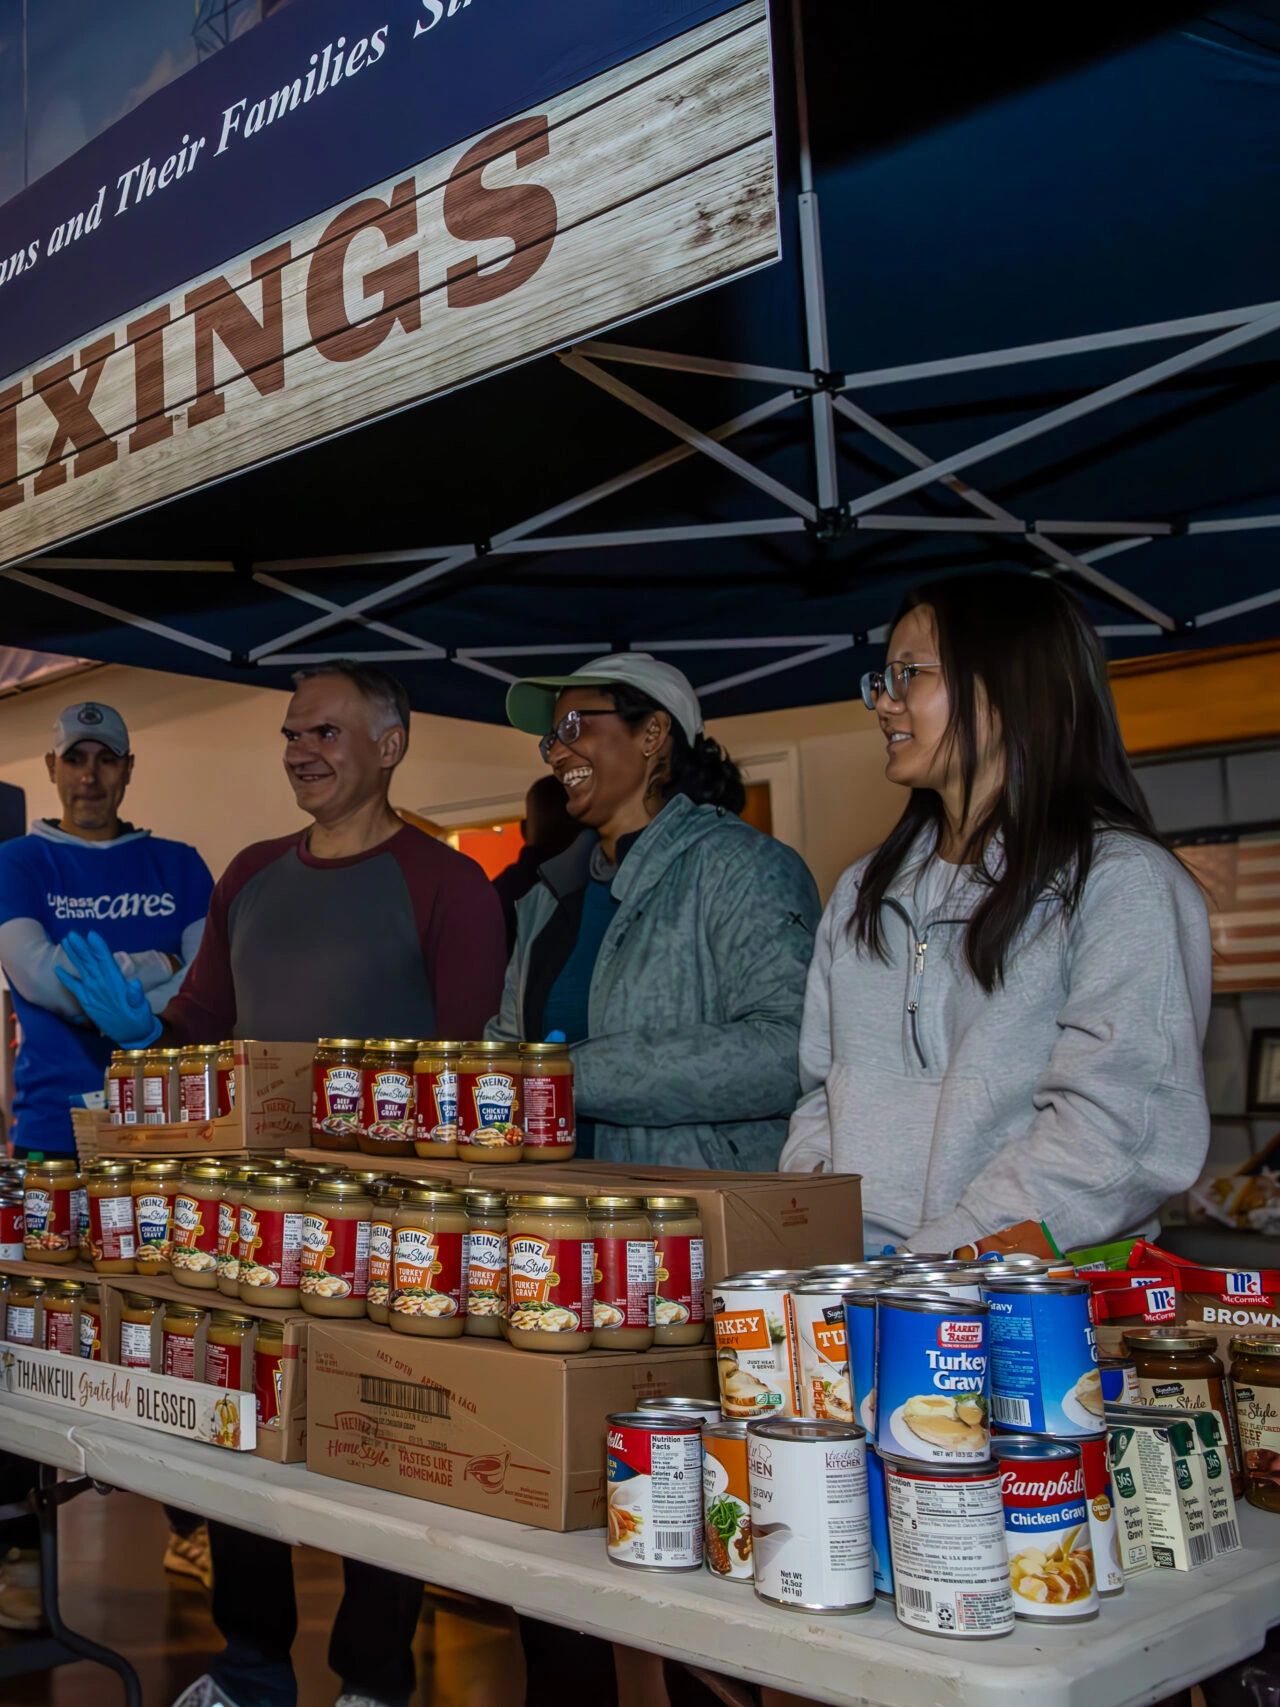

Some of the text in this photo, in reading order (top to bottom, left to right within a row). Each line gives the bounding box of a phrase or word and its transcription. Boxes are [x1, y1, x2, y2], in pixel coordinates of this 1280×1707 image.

[47, 185, 107, 256] and
[114, 134, 206, 217] Their
[213, 24, 388, 158] Families
[47, 892, 95, 907] UMass
[55, 906, 96, 919] Chan
[93, 893, 176, 920] cares
[331, 1070, 357, 1079] HEINZ
[381, 1075, 406, 1086] HEINZ
[481, 1077, 509, 1088] HEINZ
[475, 1090, 513, 1103] HomeStyle
[481, 1107, 509, 1115] CHICKEN
[484, 1113, 506, 1121] GRAVY
[140, 1199, 163, 1208] HEINZ
[399, 1232, 428, 1246] HEINZ
[514, 1242, 542, 1256] HEINZ
[395, 1248, 433, 1264] HomeStyle
[399, 1268, 424, 1276] TURKEY
[510, 1258, 550, 1277] HomeStyle
[400, 1275, 422, 1284] GRAVY
[469, 1278, 494, 1286] GRAVY
[515, 1281, 540, 1290] TURKEY
[515, 1288, 538, 1297] GRAVY
[1221, 1294, 1270, 1304] McCormick
[1144, 1312, 1176, 1322] McCorm
[945, 1323, 980, 1333] MARKET
[817, 1329, 847, 1347] TU
[947, 1333, 979, 1341] BASKET
[925, 1350, 988, 1375] Turkey
[932, 1371, 985, 1395] Gravy
[17, 1360, 196, 1430] THANKFUL Grateful BLESSED
[1248, 1402, 1278, 1425] Style
[341, 1417, 372, 1436] HEINZ
[652, 1435, 681, 1443] Nutrition
[1240, 1428, 1262, 1440] BEEF
[652, 1443, 671, 1451] Facts
[327, 1440, 391, 1467] HomeStyle
[398, 1449, 453, 1472] TASTES LIKE
[826, 1458, 861, 1468] KITCHEN
[1207, 1455, 1220, 1469] 365
[399, 1465, 453, 1487] HOMEMADE
[673, 1471, 684, 1480] 40
[1177, 1465, 1189, 1480] 365
[1116, 1473, 1133, 1489] 365
[753, 1486, 774, 1503] gravy
[1210, 1497, 1228, 1510] Turkey
[1010, 1505, 1086, 1526] Chicken Gravy
[1185, 1509, 1204, 1521] Turkey
[1212, 1508, 1229, 1520] Gravy
[911, 1519, 918, 1530] 5
[1124, 1518, 1143, 1530] Turkey
[1189, 1520, 1205, 1532] Gravy
[1127, 1529, 1144, 1541] Gravy
[780, 1570, 802, 1580] Net Wt
[781, 1578, 802, 1588] 14.5oz
[781, 1587, 803, 1597] (411g)
